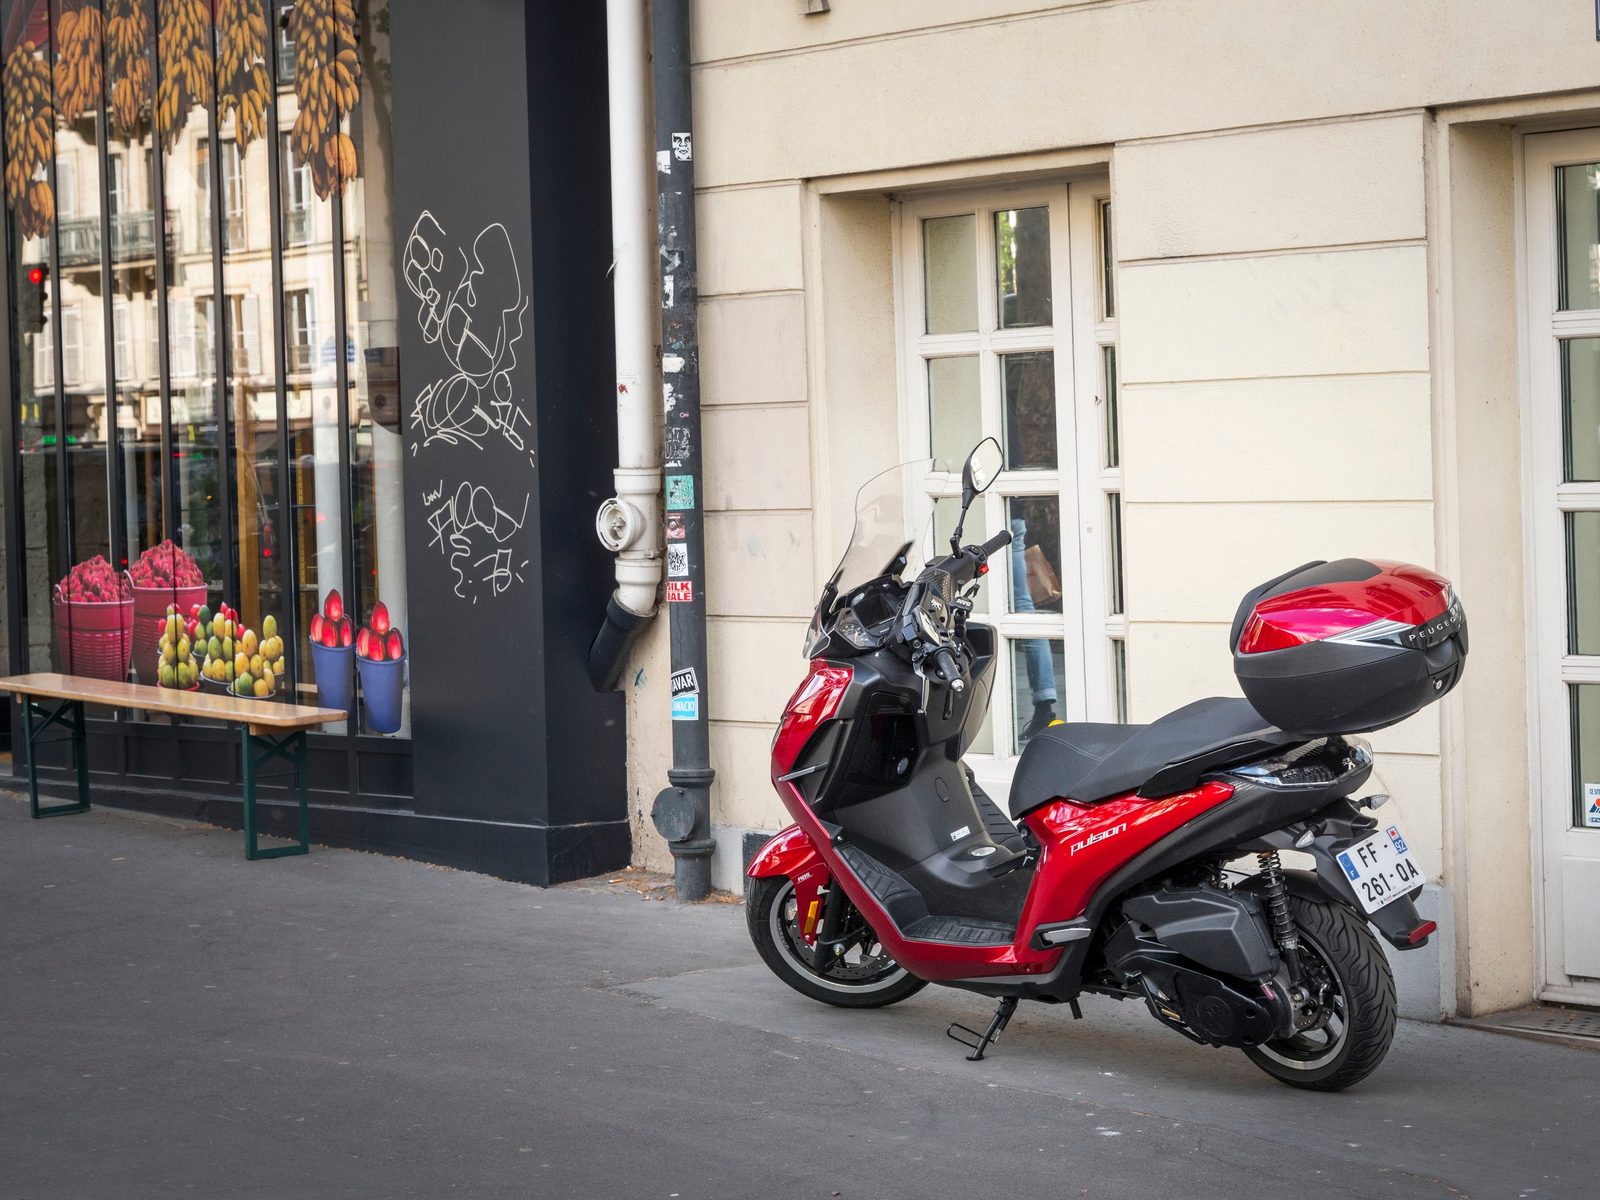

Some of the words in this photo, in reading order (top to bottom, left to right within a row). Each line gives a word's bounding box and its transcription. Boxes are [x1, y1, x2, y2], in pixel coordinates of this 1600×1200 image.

[1408, 616, 1458, 642] PEUGEO
[672, 673, 694, 692] AVAR
[1070, 823, 1127, 857] pulsion
[1394, 839, 1406, 852] 92
[1350, 870, 1355, 878] F
[1361, 858, 1419, 902] 261-QA
